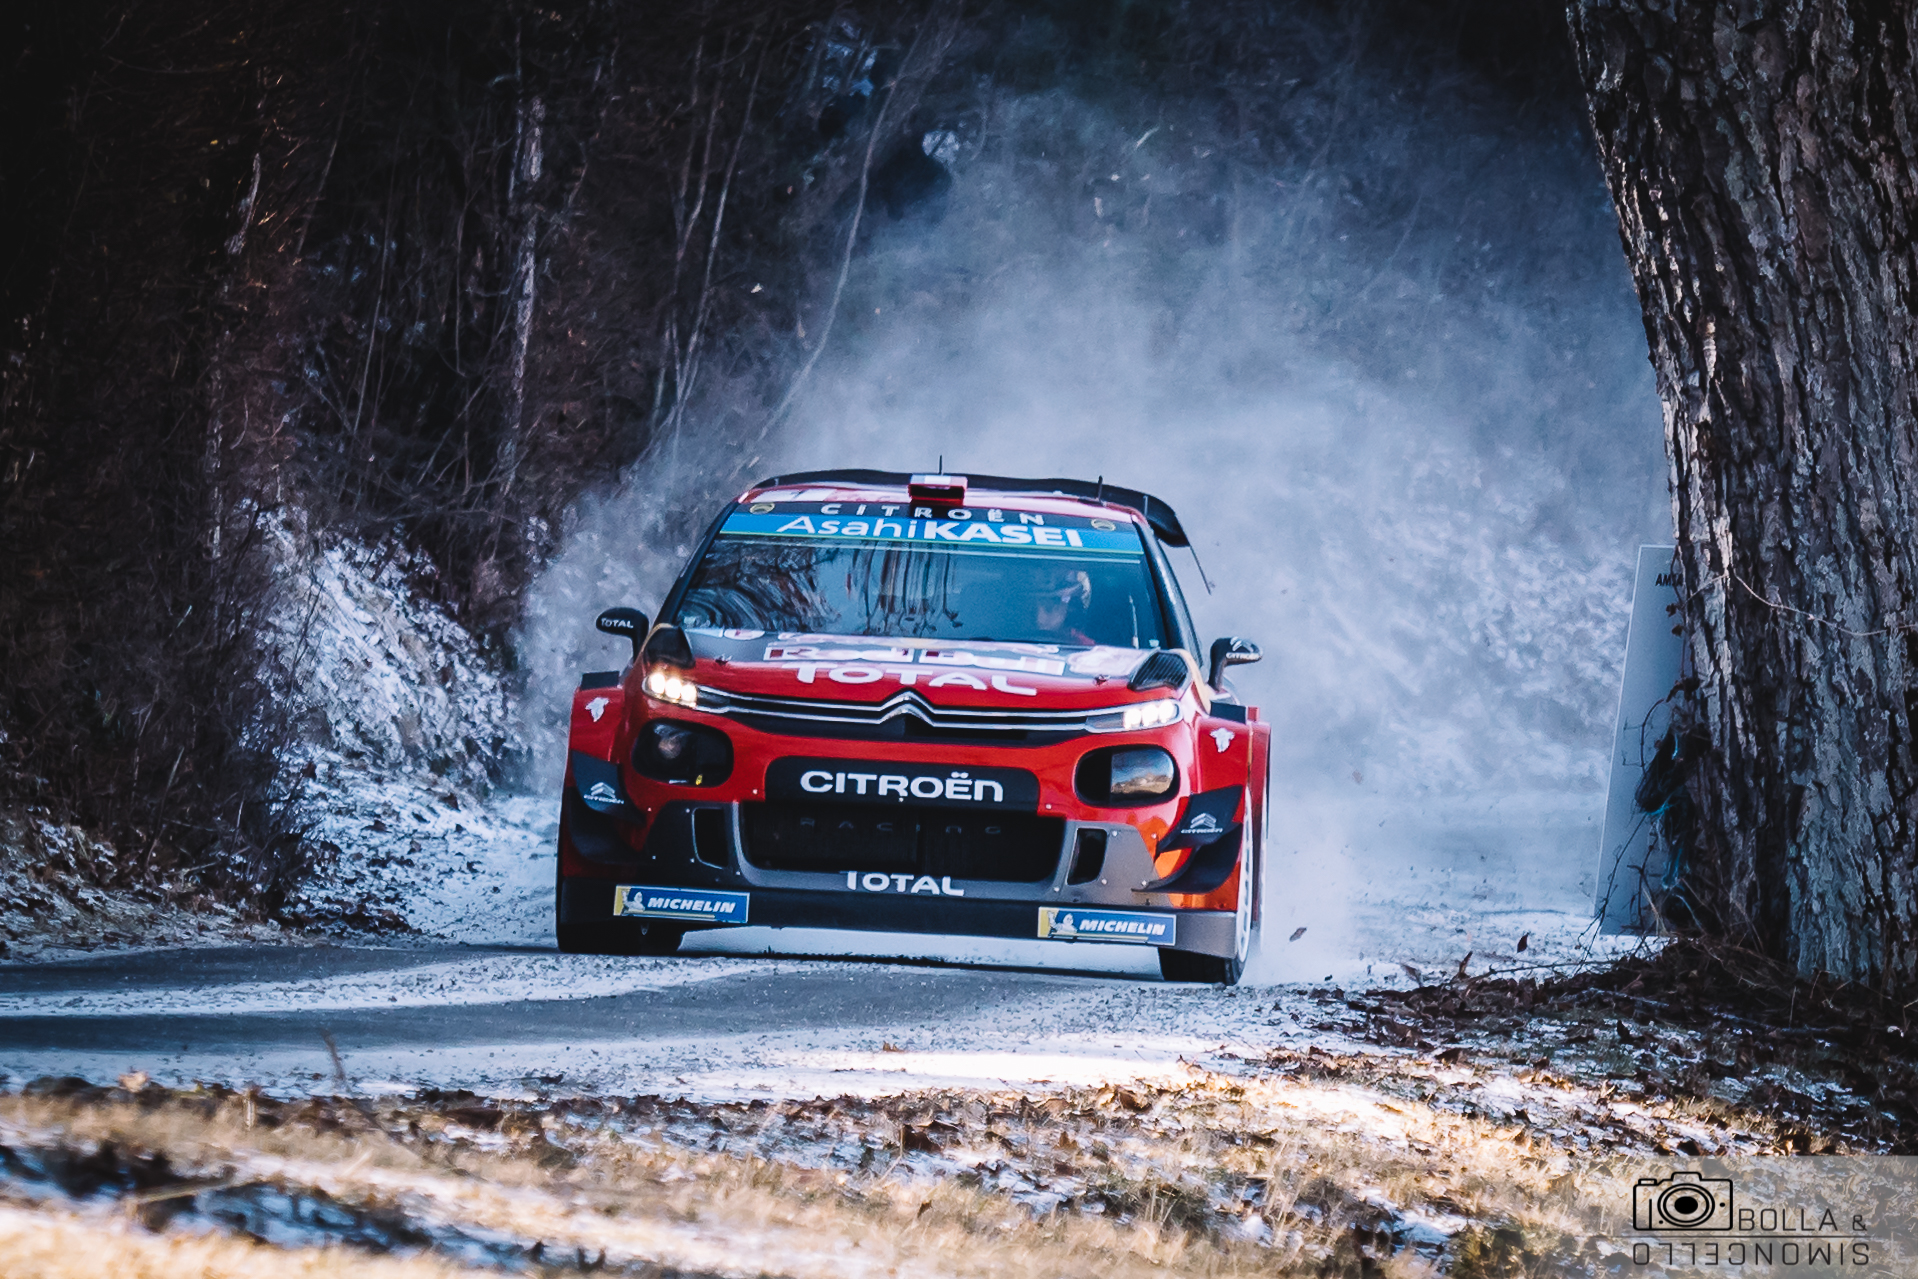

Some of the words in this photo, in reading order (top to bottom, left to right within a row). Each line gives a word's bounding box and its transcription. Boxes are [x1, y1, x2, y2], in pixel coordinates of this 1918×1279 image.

[601, 618, 634, 629] TOTAL
[782, 662, 1037, 696] TOTAL
[839, 871, 965, 897] TOTAL
[647, 897, 736, 914] MICHELIN
[1079, 918, 1166, 936] MICHELIN
